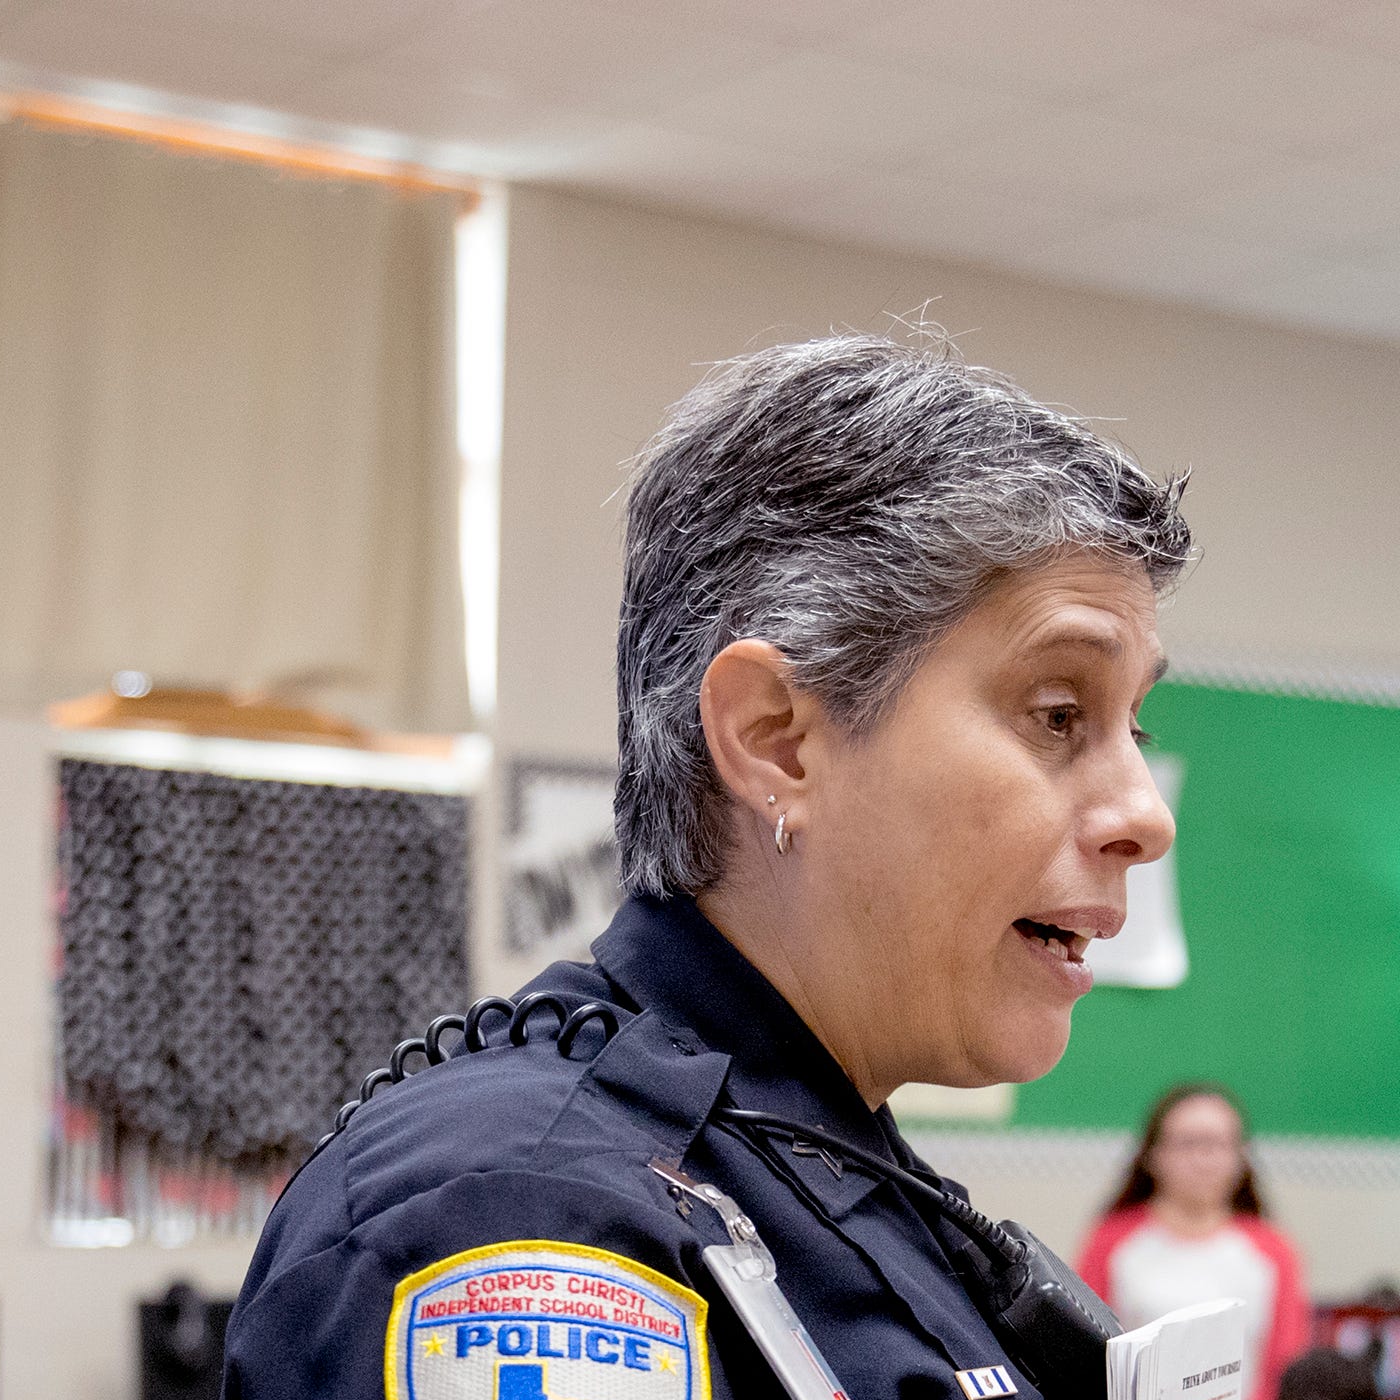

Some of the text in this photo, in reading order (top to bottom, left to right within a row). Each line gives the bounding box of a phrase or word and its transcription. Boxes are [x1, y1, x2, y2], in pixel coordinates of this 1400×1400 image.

[465, 1272, 647, 1315] CORPUS CHRISTI
[420, 1297, 681, 1339] INDEPENDENT SCHOOL DISTRICT
[456, 1324, 652, 1371] POLICE
